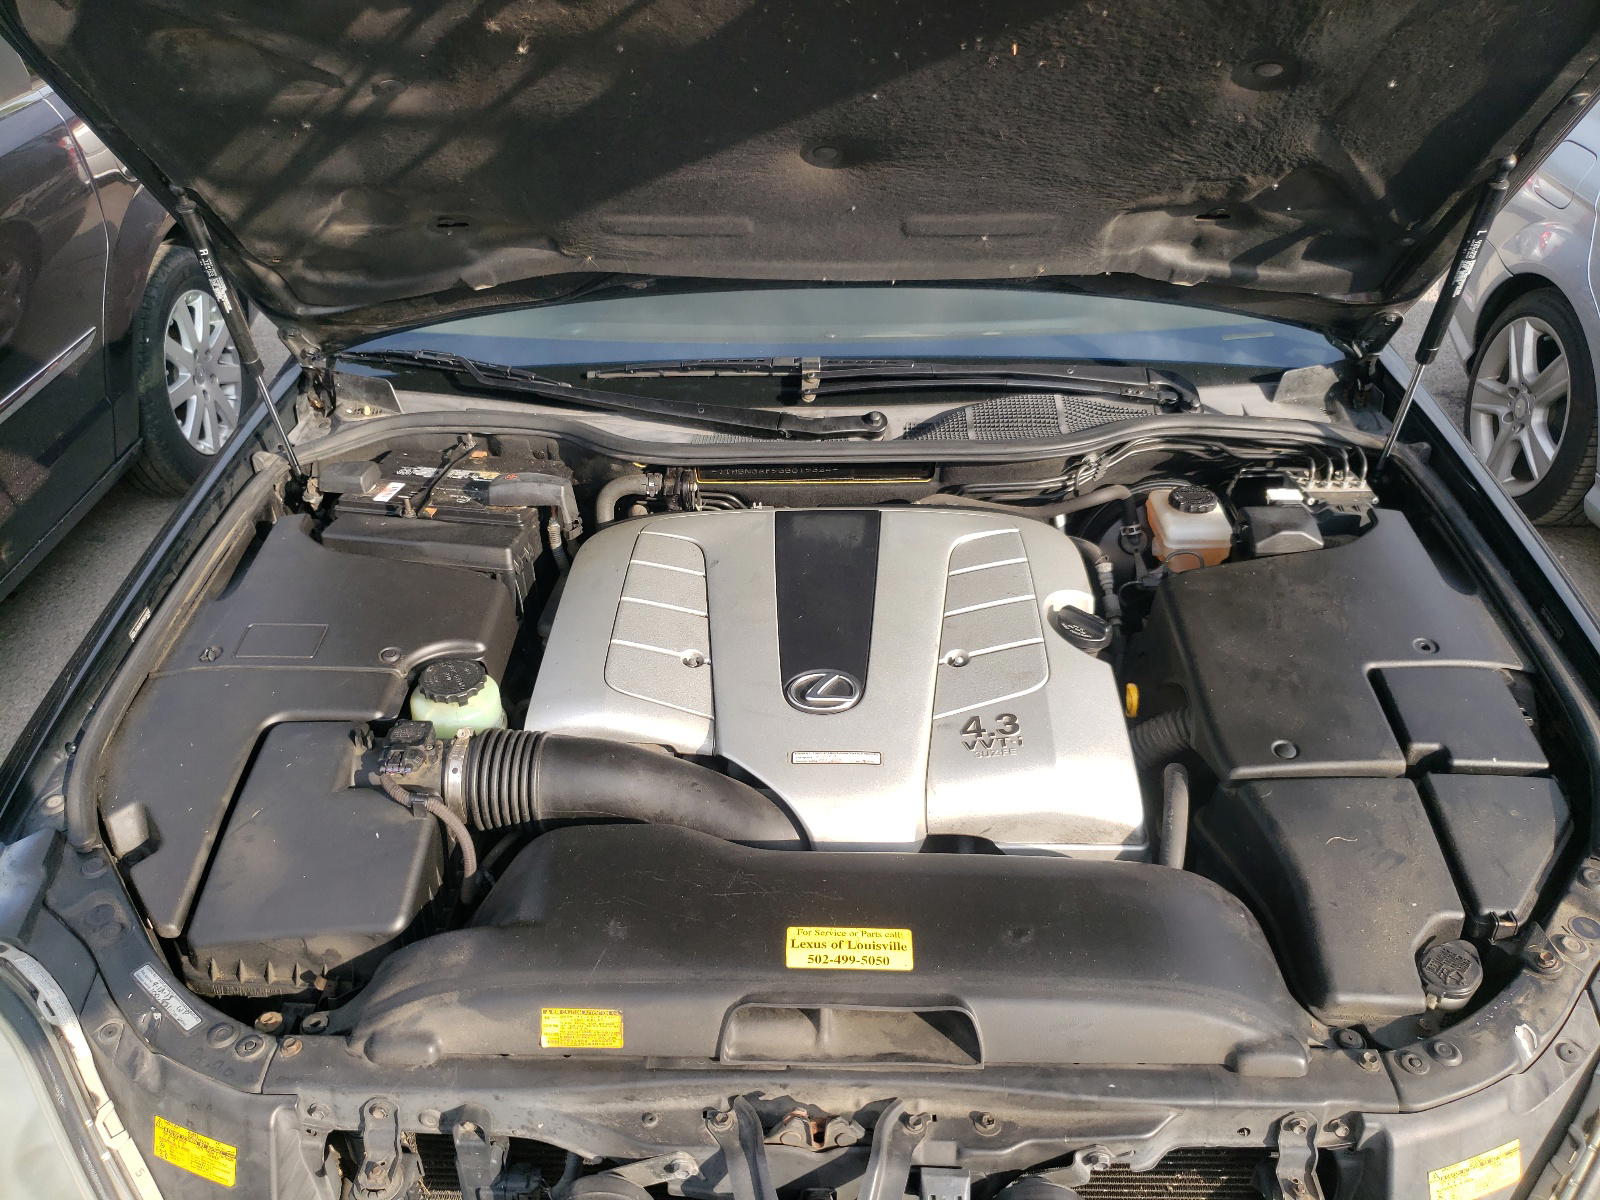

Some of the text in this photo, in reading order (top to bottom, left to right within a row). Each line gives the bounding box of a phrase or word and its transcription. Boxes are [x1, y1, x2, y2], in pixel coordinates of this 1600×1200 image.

[960, 713, 1020, 738] 4.3
[797, 928, 813, 936] For
[814, 928, 847, 937] Service
[861, 930, 883, 938] Parts
[791, 939, 908, 951] Lexus of Louisville
[807, 954, 890, 966] 502-499-5050
